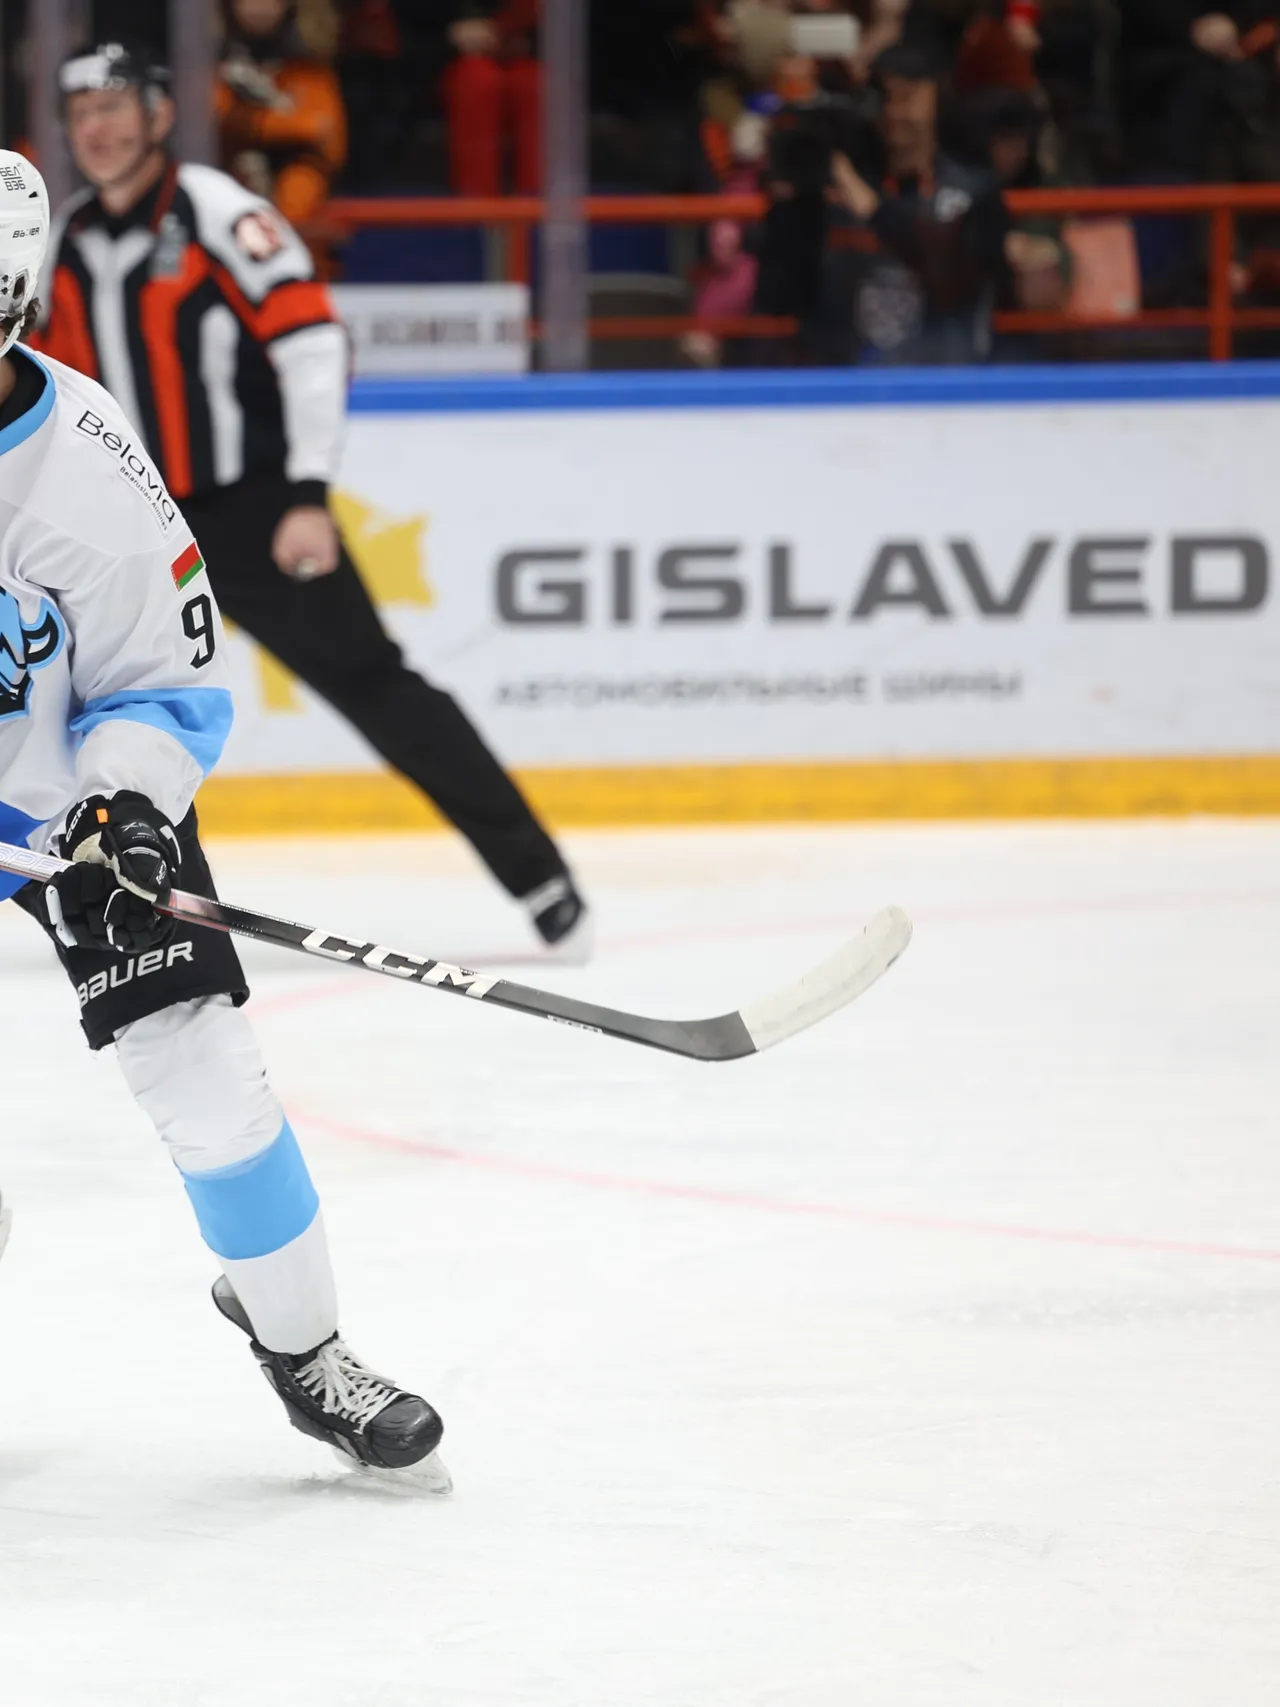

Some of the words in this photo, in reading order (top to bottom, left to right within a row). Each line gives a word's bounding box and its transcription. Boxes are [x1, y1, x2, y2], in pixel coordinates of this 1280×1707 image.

[76, 410, 175, 523] Belavia
[119, 466, 152, 501] Belarusian
[493, 534, 1271, 629] GISLAVED
[180, 592, 216, 670] 9
[65, 800, 89, 843] CCM
[301, 928, 502, 999] CCM
